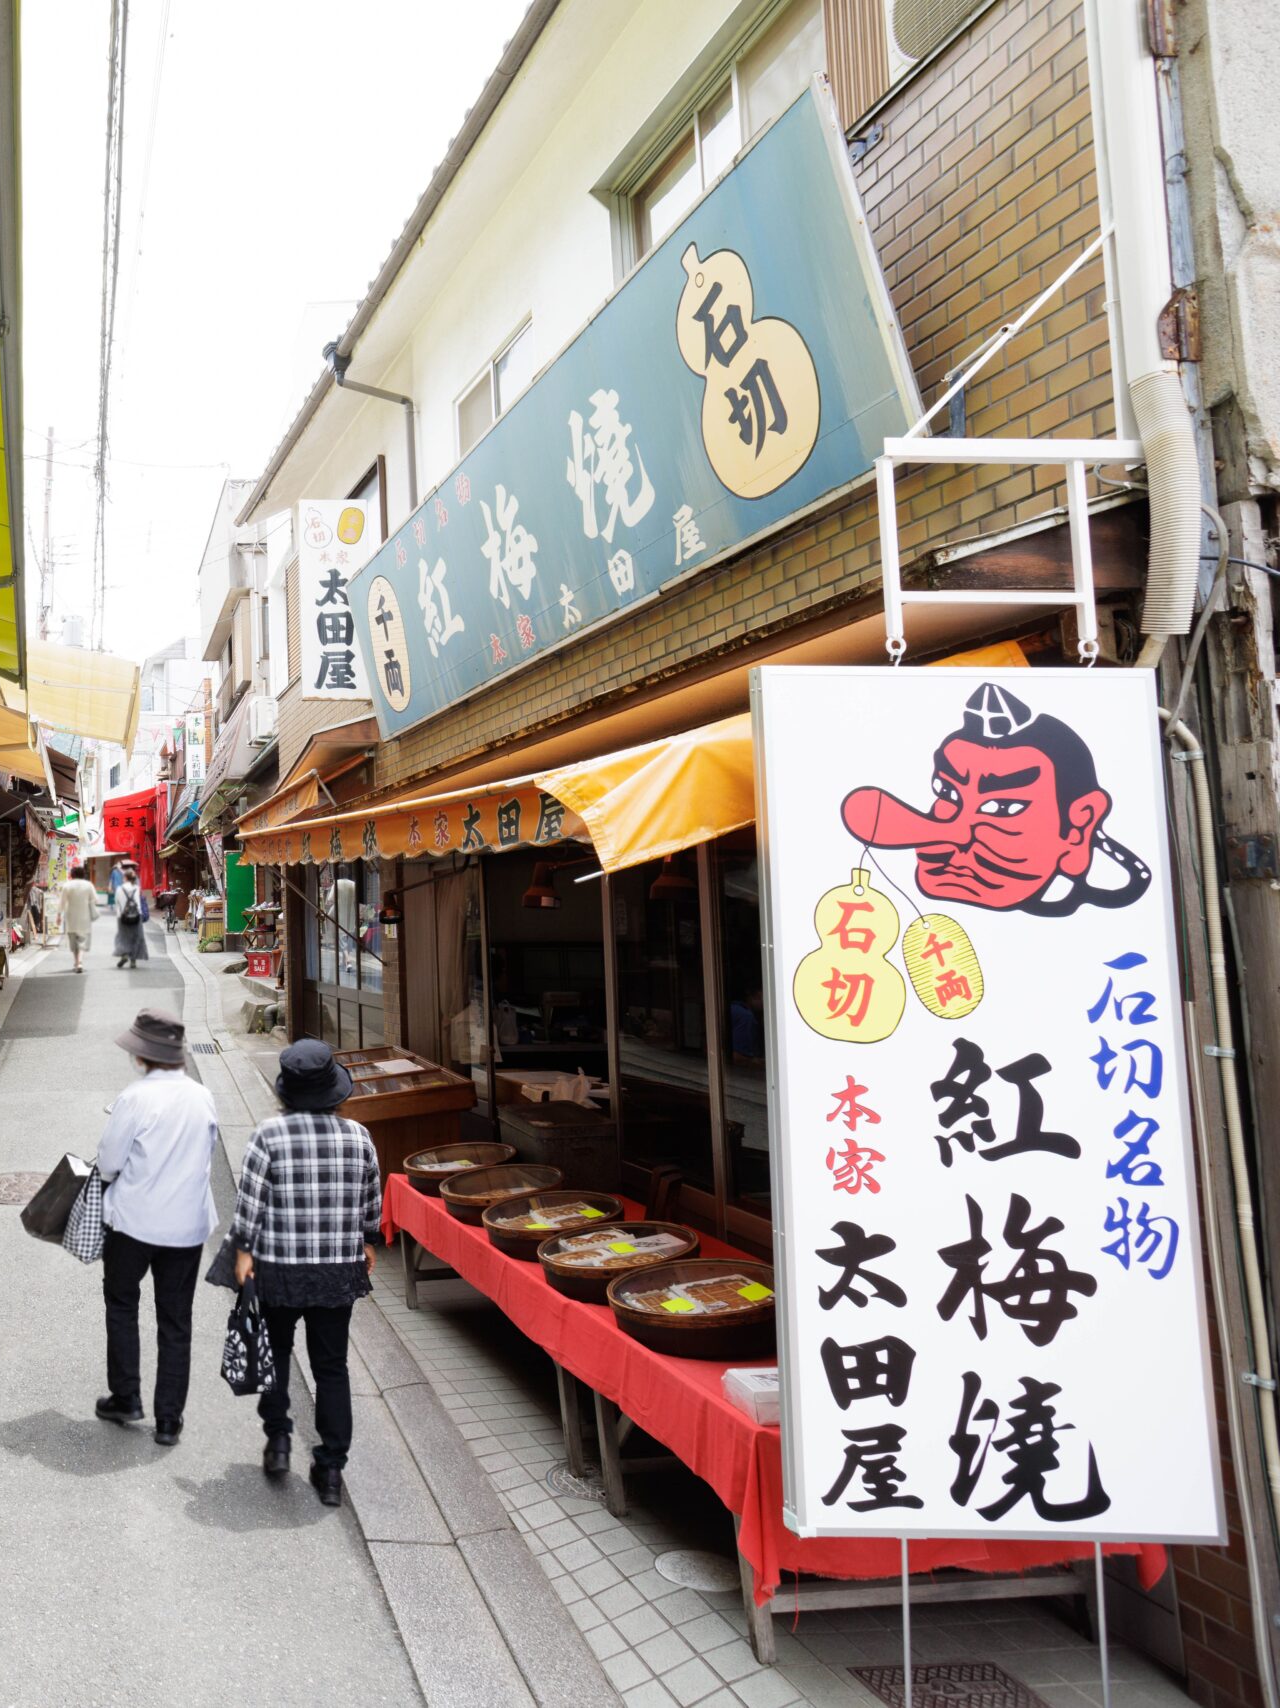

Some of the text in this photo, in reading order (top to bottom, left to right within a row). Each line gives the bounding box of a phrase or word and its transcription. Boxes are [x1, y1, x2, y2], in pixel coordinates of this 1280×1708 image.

[693, 282, 787, 460] 石切
[314, 568, 357, 690] 太田屋
[375, 594, 405, 697] 千両
[461, 793, 565, 850] 太田屋
[820, 900, 877, 1027] 石切
[920, 932, 973, 1008] 千両
[1086, 951, 1180, 1280] 石切名物
[814, 1074, 925, 1512] 本家 太田屋
